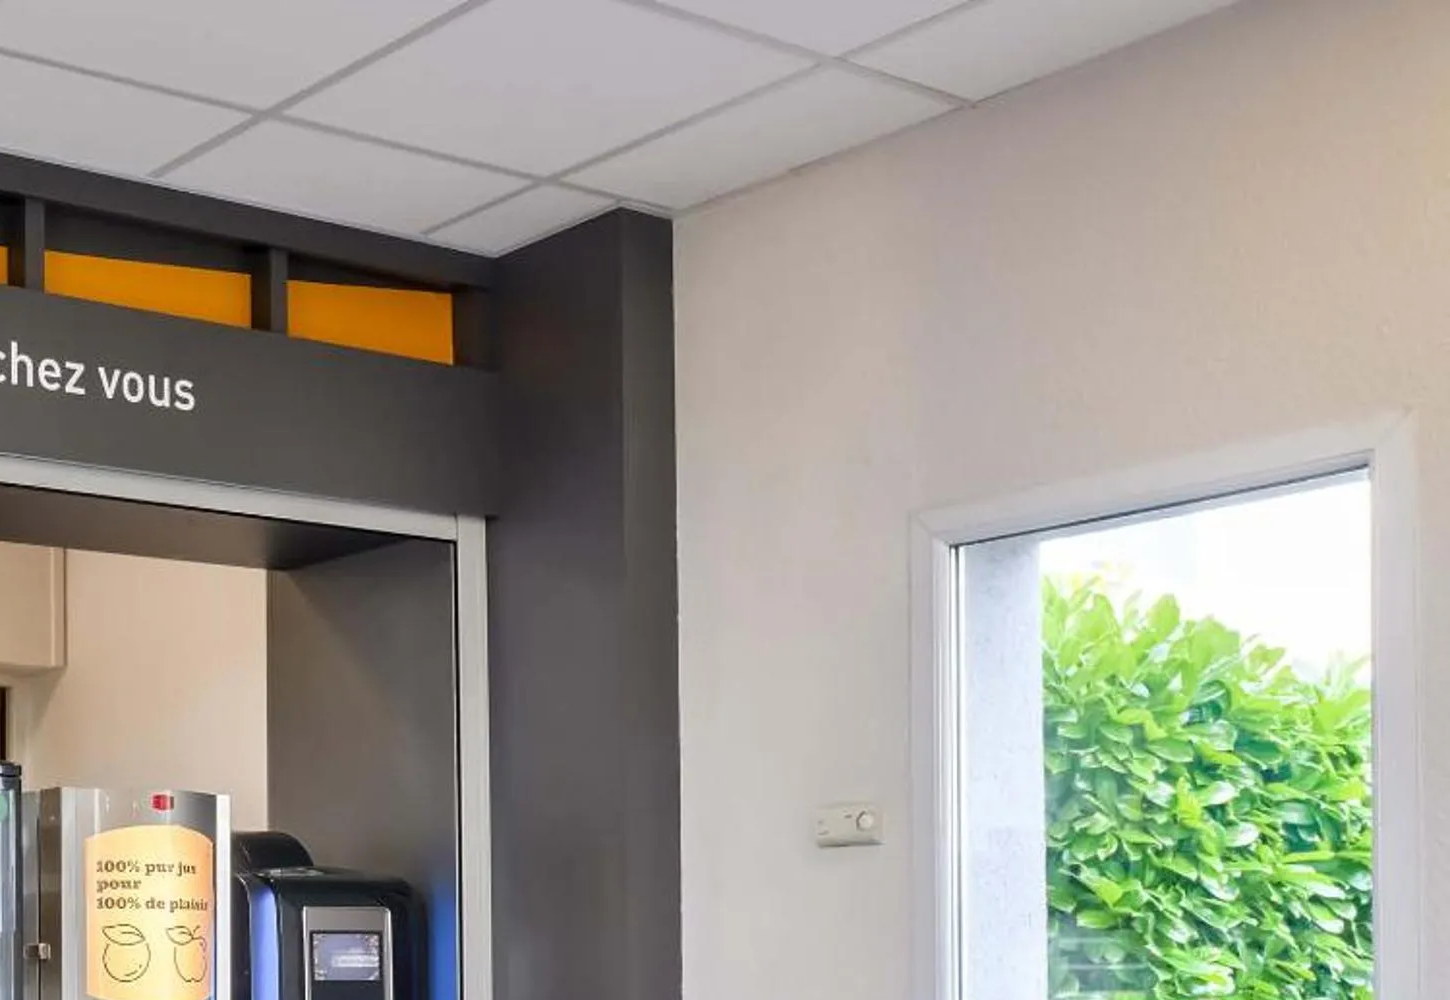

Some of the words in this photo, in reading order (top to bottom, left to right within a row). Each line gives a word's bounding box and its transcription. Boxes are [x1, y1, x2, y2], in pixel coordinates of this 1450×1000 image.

[99, 366, 195, 411] vous
[96, 860, 140, 873] 100%
[145, 863, 174, 876] pur
[177, 861, 197, 877] jus
[96, 880, 142, 893] pour
[96, 897, 141, 910] 100%
[145, 897, 166, 909] de
